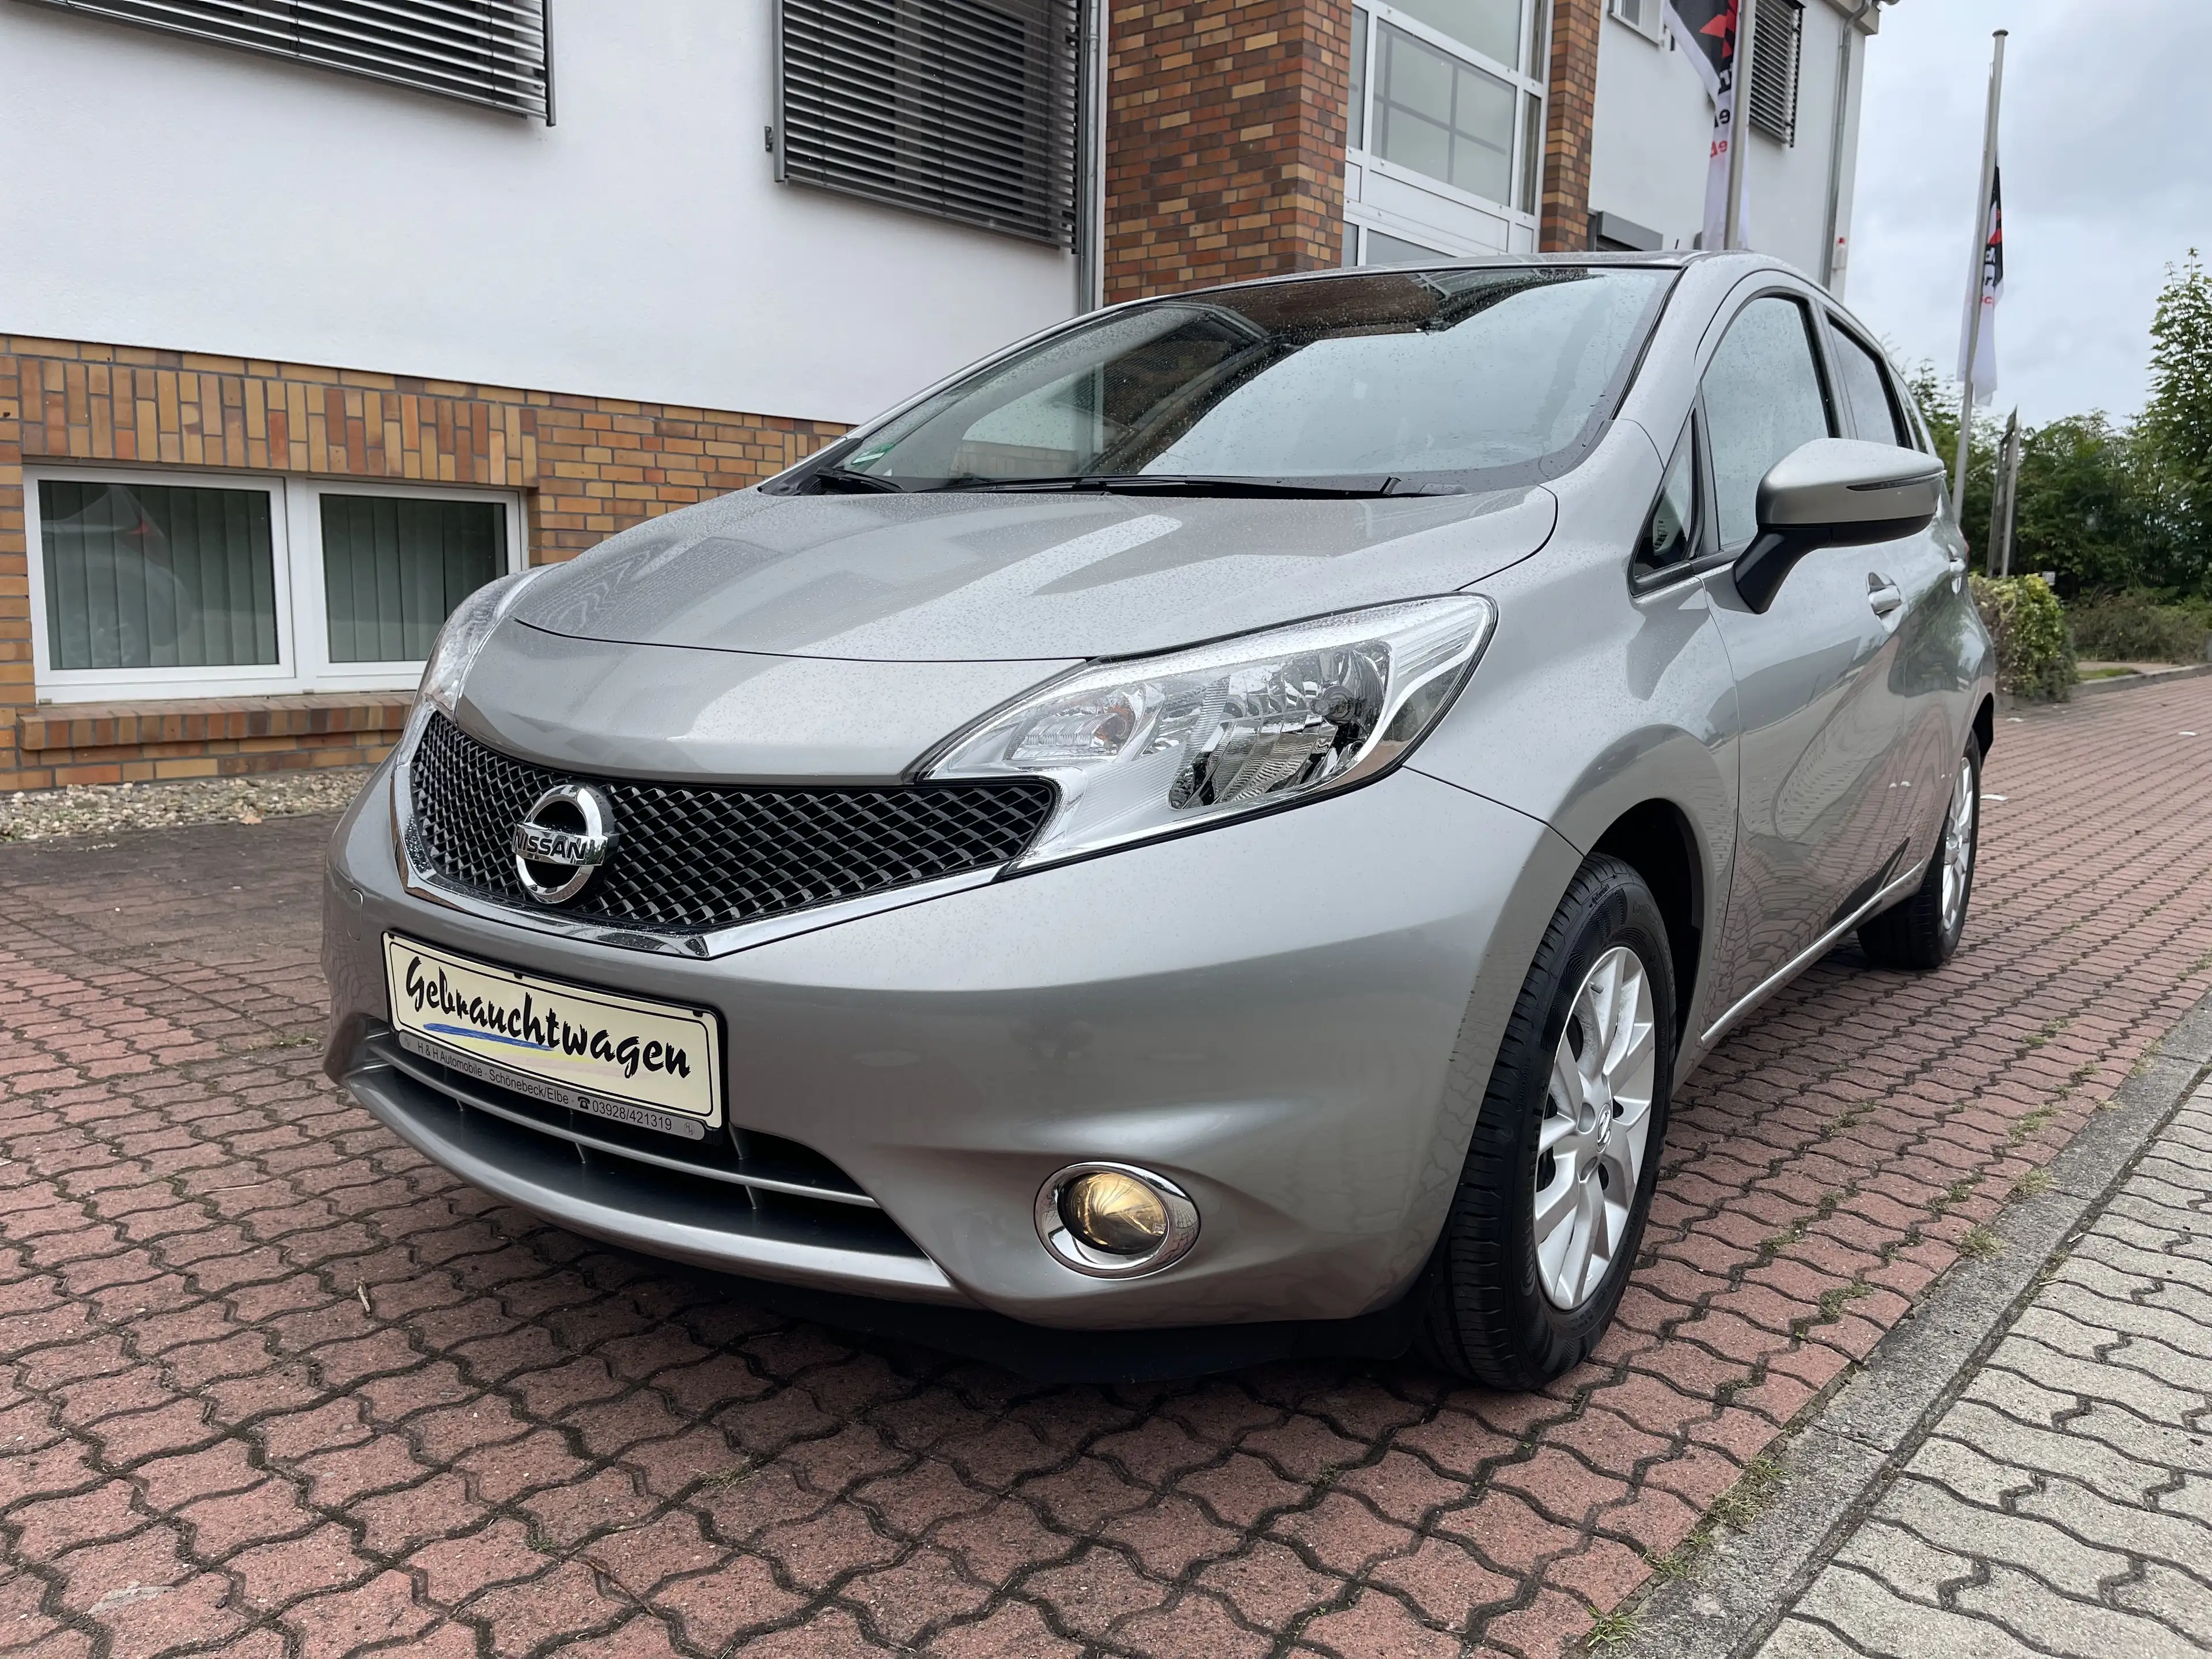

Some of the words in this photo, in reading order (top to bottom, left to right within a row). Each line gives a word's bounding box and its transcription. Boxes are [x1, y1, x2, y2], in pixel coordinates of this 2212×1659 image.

[515, 834, 586, 860] NISSAN
[405, 956, 692, 1079] Gebrauchtwagen
[418, 1041, 424, 1054] H
[425, 1045, 431, 1056] &
[433, 1048, 439, 1060] H
[440, 1052, 483, 1077] Automobile
[489, 1069, 569, 1105] Schönebeck/Elbe
[592, 1100, 672, 1131] 03928/421319
